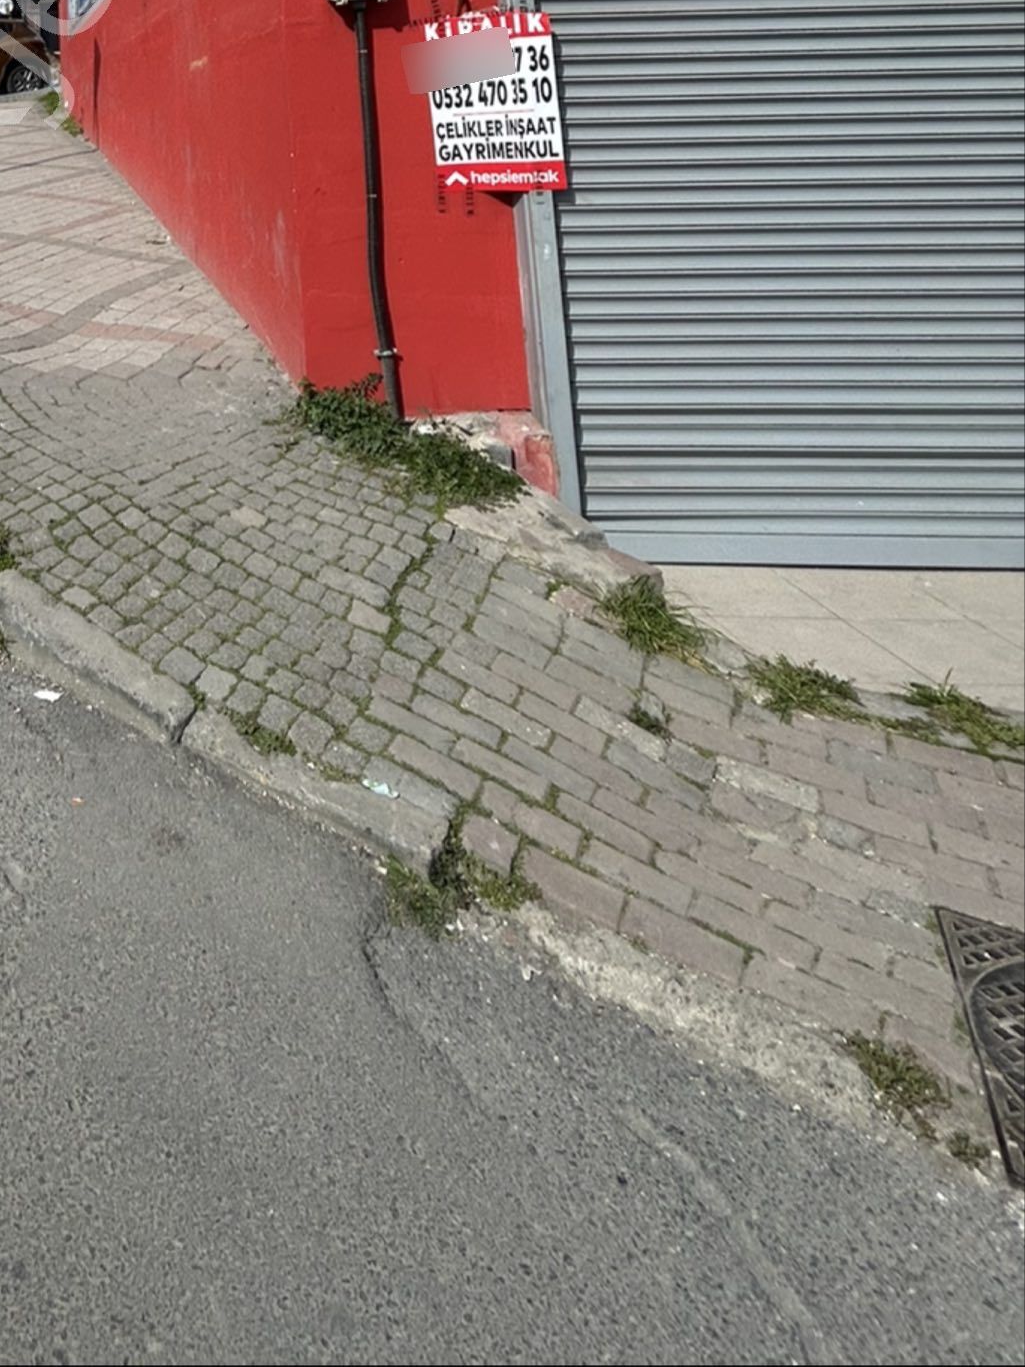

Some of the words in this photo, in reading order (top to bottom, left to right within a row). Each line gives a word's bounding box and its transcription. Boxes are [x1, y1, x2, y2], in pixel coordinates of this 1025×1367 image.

[527, 44, 550, 72] 36
[432, 83, 473, 109] 0532
[478, 79, 507, 107] 470
[511, 77, 528, 104] 35
[532, 75, 553, 103] 10
[436, 116, 502, 142] ÇELİKLER
[506, 114, 556, 139] İNŞAAT
[439, 137, 559, 162] GAYRİMENKUL
